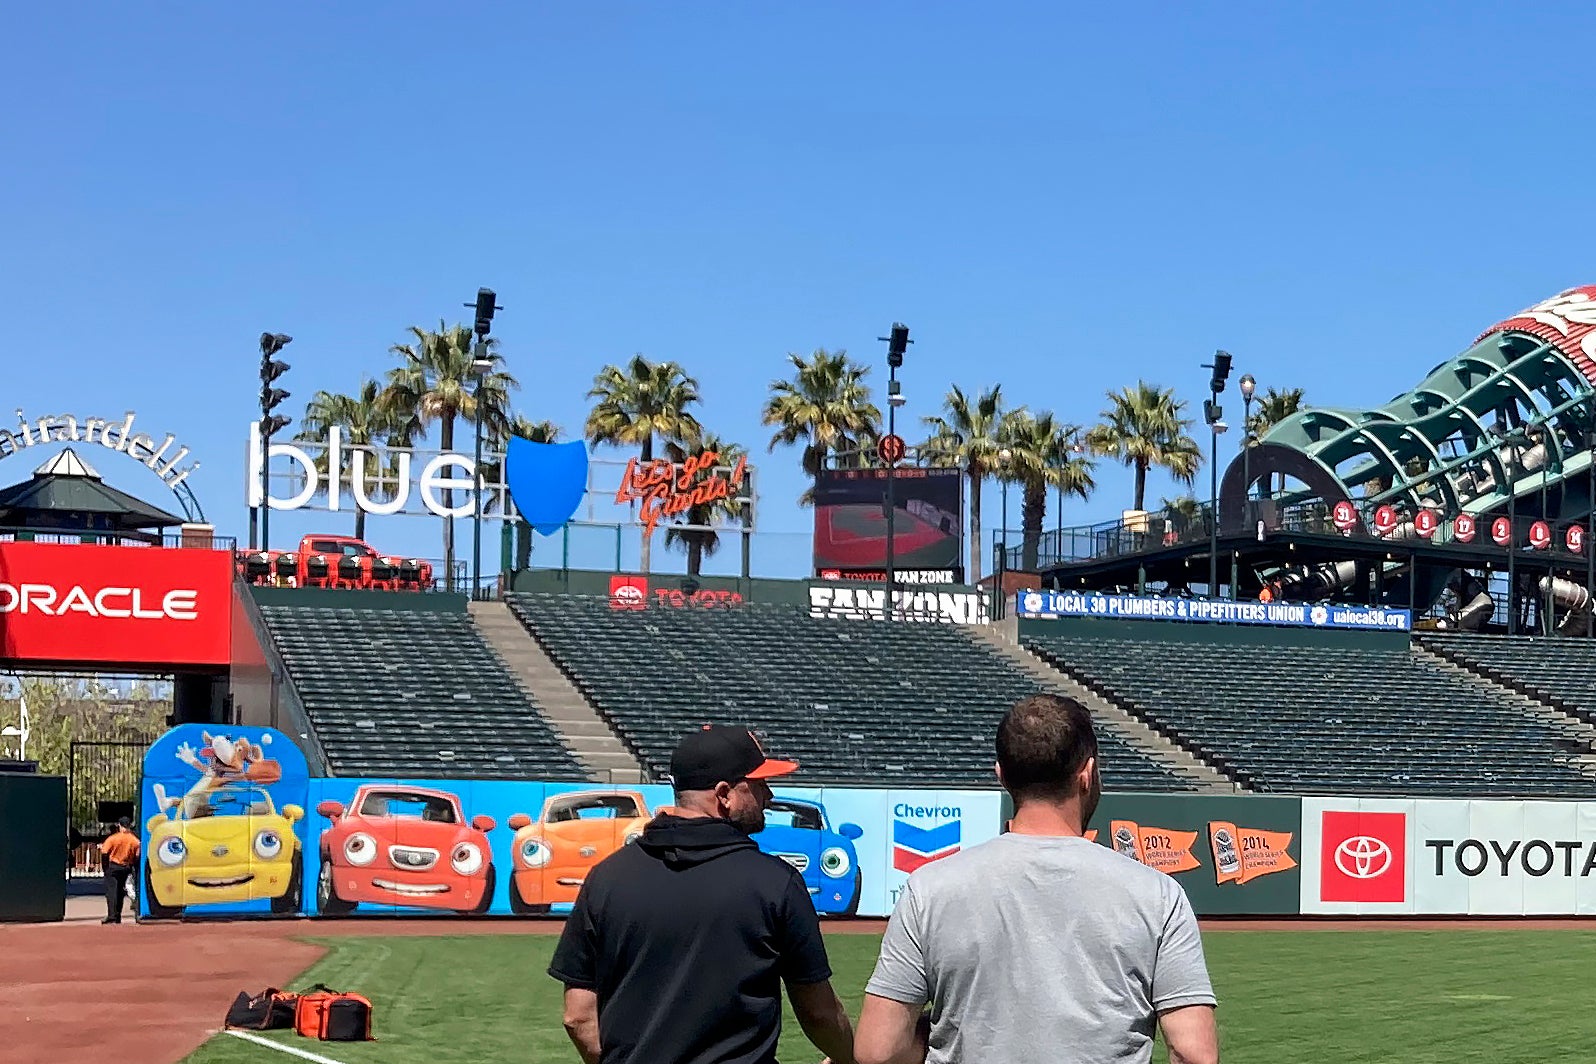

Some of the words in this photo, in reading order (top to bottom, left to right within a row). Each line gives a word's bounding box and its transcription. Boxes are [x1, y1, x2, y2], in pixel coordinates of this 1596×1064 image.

[0, 408, 201, 488] irardelli
[249, 421, 484, 518] blue
[893, 571, 919, 584] FAN
[809, 587, 885, 621] FAN
[1050, 594, 1088, 613] LOCAL
[1091, 597, 1106, 613] 38
[1109, 598, 1174, 616] PLUMBERS
[1177, 602, 1187, 617] &
[1189, 601, 1266, 620] PIPEFITTERS
[1268, 605, 1305, 622] UNION
[1333, 609, 1406, 629] ualocal38.org
[894, 803, 961, 818] Chevron
[1144, 835, 1171, 850] 2012
[1243, 836, 1269, 851] 2014
